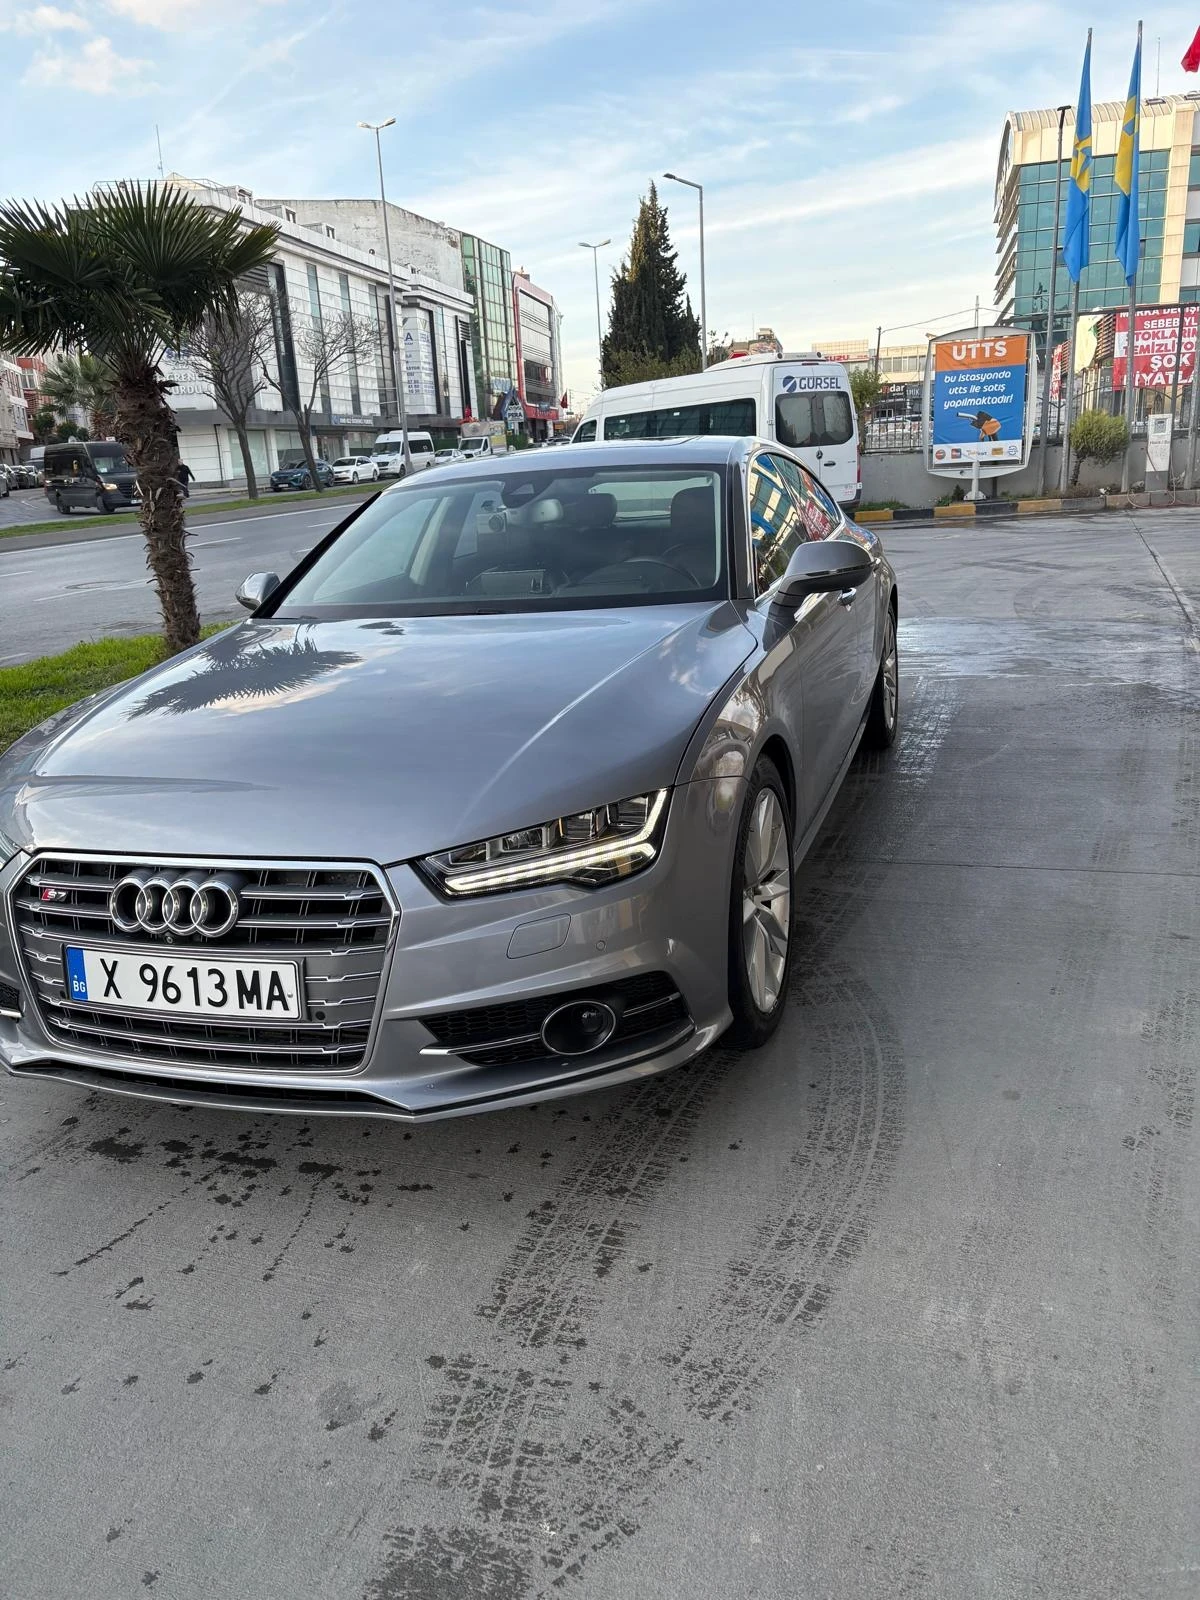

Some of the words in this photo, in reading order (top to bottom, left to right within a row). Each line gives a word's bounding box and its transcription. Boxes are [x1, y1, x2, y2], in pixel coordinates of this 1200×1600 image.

[952, 340, 1007, 361] UTTS
[1150, 353, 1191, 373] ŞOK
[799, 376, 841, 390] GÜRSEL
[944, 374, 956, 383] bu
[958, 370, 1011, 383] istasyonda
[948, 386, 967, 395] utts
[969, 384, 981, 393] ile
[983, 383, 1006, 393] satış
[943, 393, 1013, 410] yapılmaktadır!
[47, 889, 66, 900] S7
[73, 980, 86, 993] BG
[100, 958, 122, 999] X
[138, 963, 228, 1008] 9613
[235, 969, 290, 1011] MA
